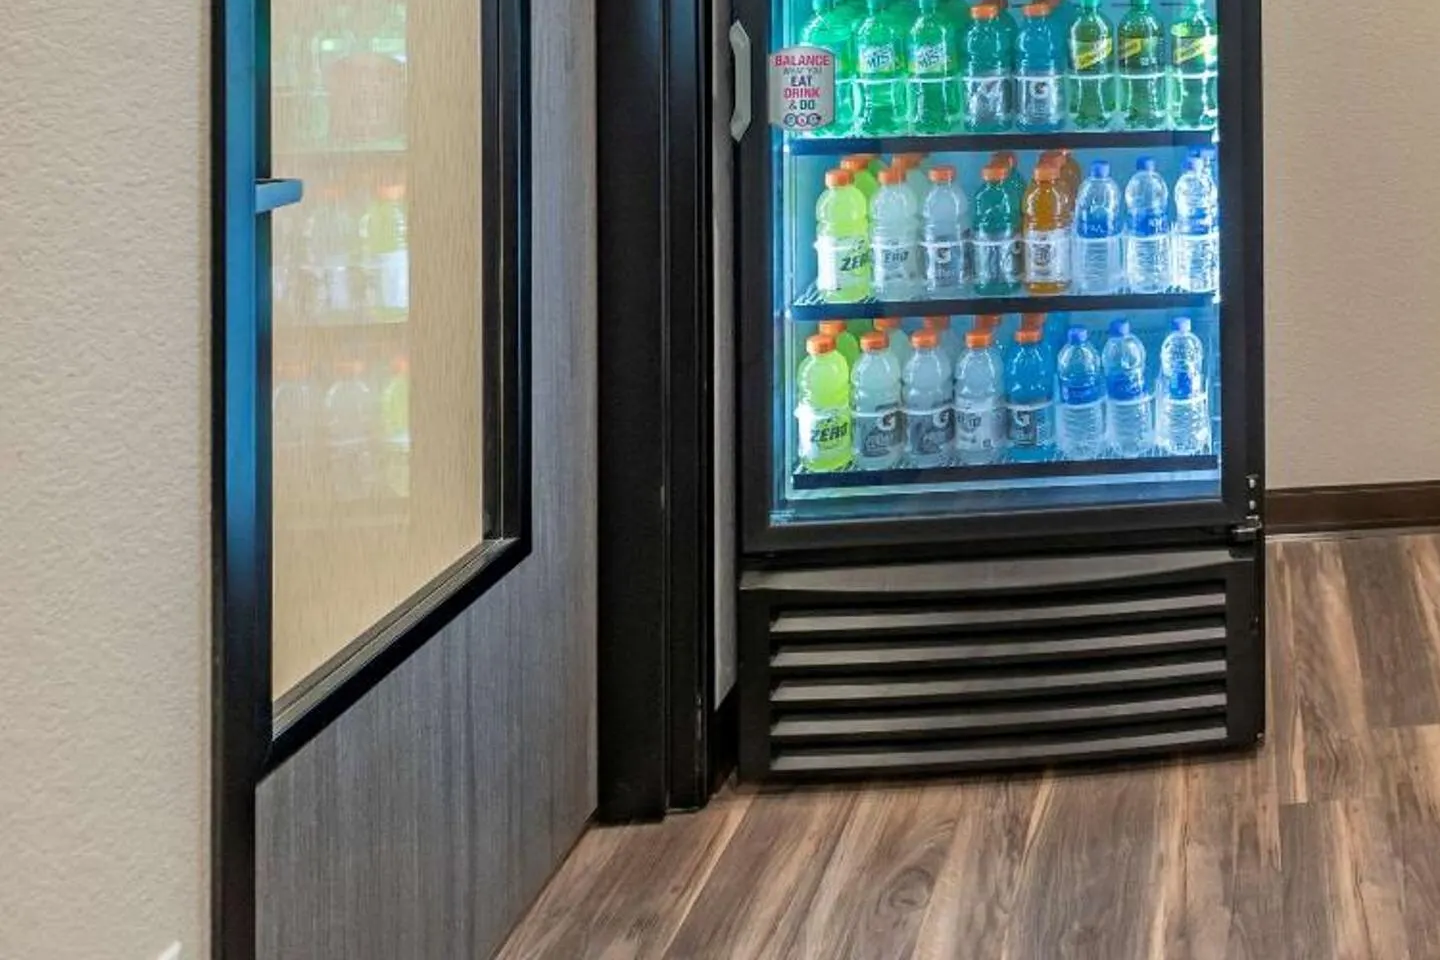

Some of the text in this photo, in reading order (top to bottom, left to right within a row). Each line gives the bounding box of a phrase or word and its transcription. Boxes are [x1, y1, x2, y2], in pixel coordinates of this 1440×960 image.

[775, 55, 830, 66] BALANCE
[791, 75, 812, 86] EAT
[784, 87, 821, 99] DRINK
[799, 100, 816, 110] DO
